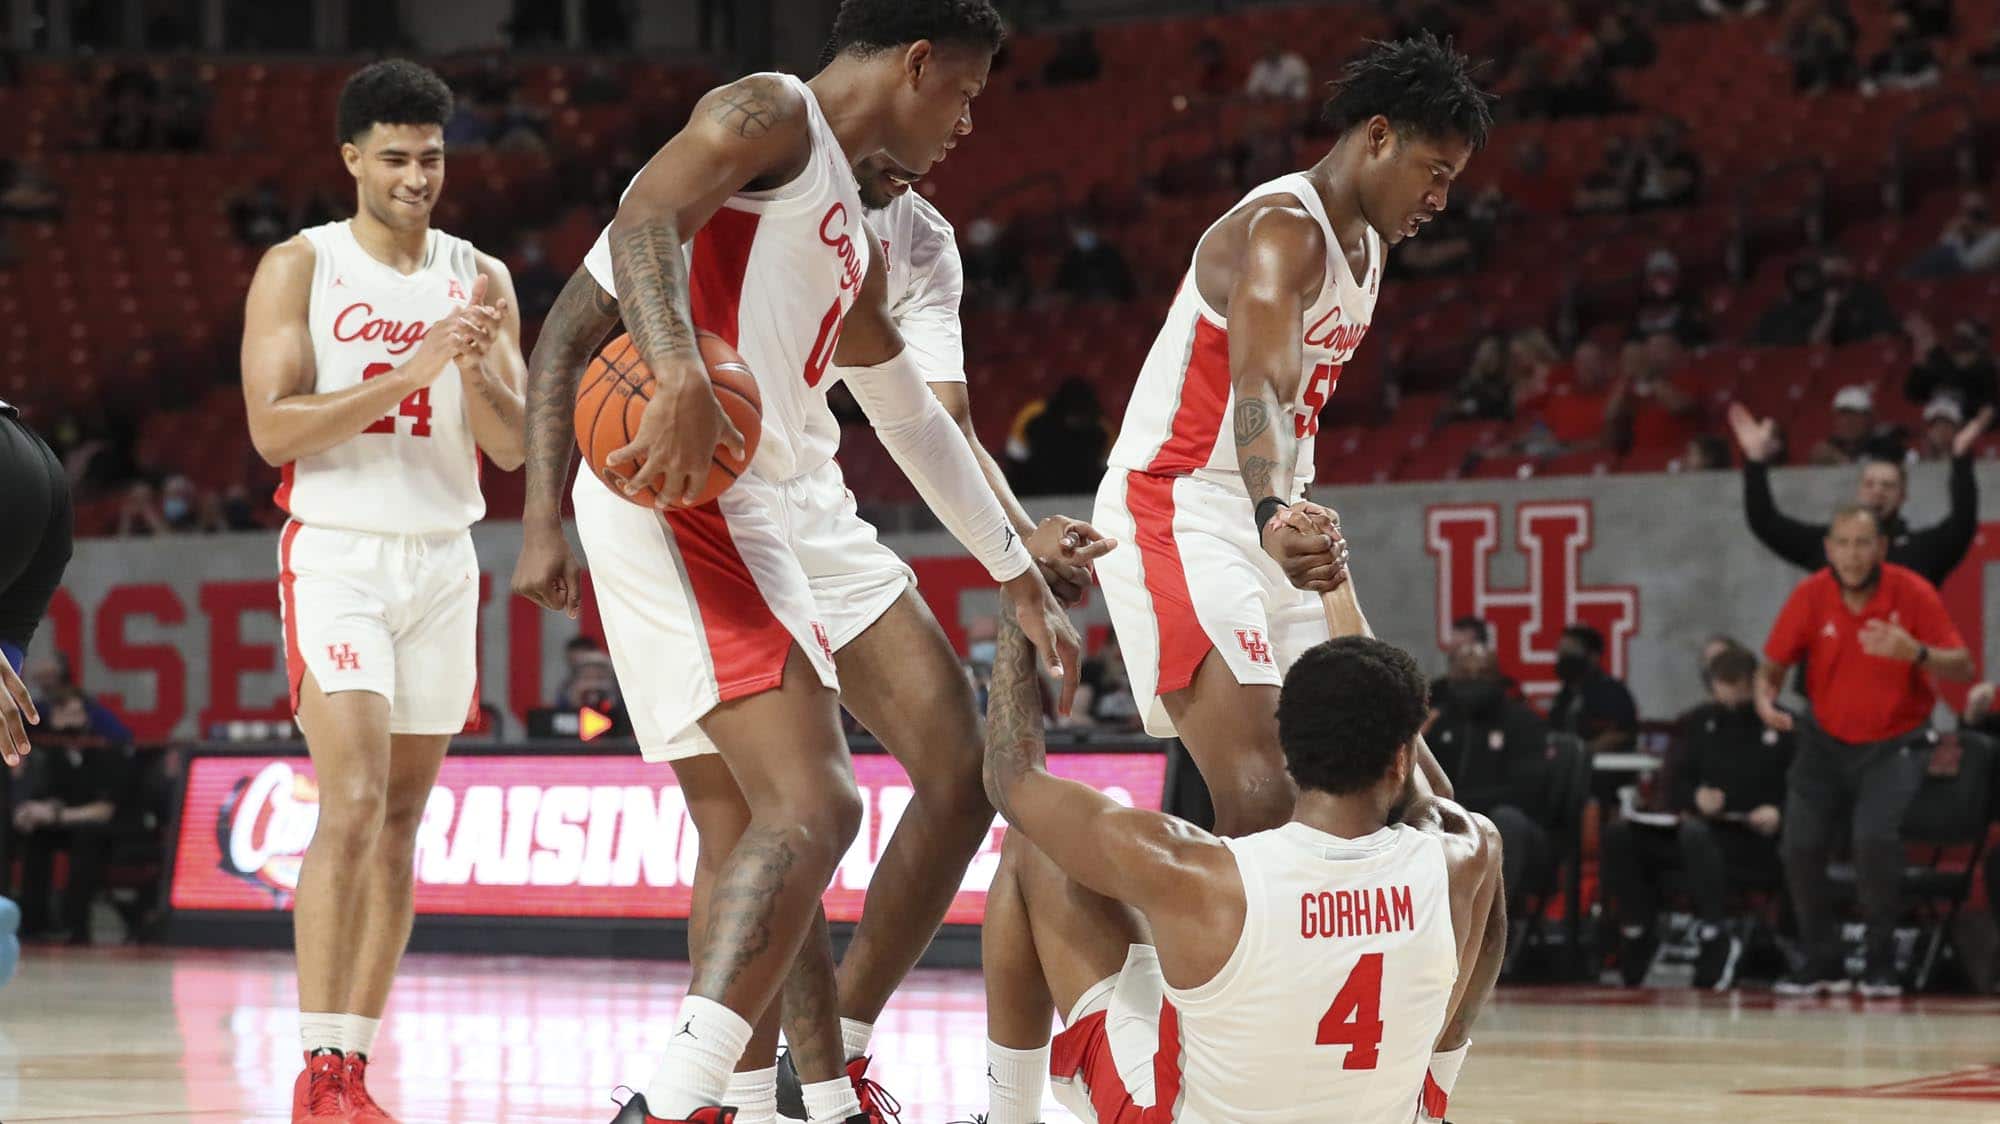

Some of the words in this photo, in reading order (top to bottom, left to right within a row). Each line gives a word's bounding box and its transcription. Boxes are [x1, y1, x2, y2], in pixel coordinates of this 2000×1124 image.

[333, 302, 432, 355] Coug
[413, 786, 699, 887] RAISIN
[1301, 885, 1414, 938] GORHAM
[1315, 952, 1384, 1070] 4
